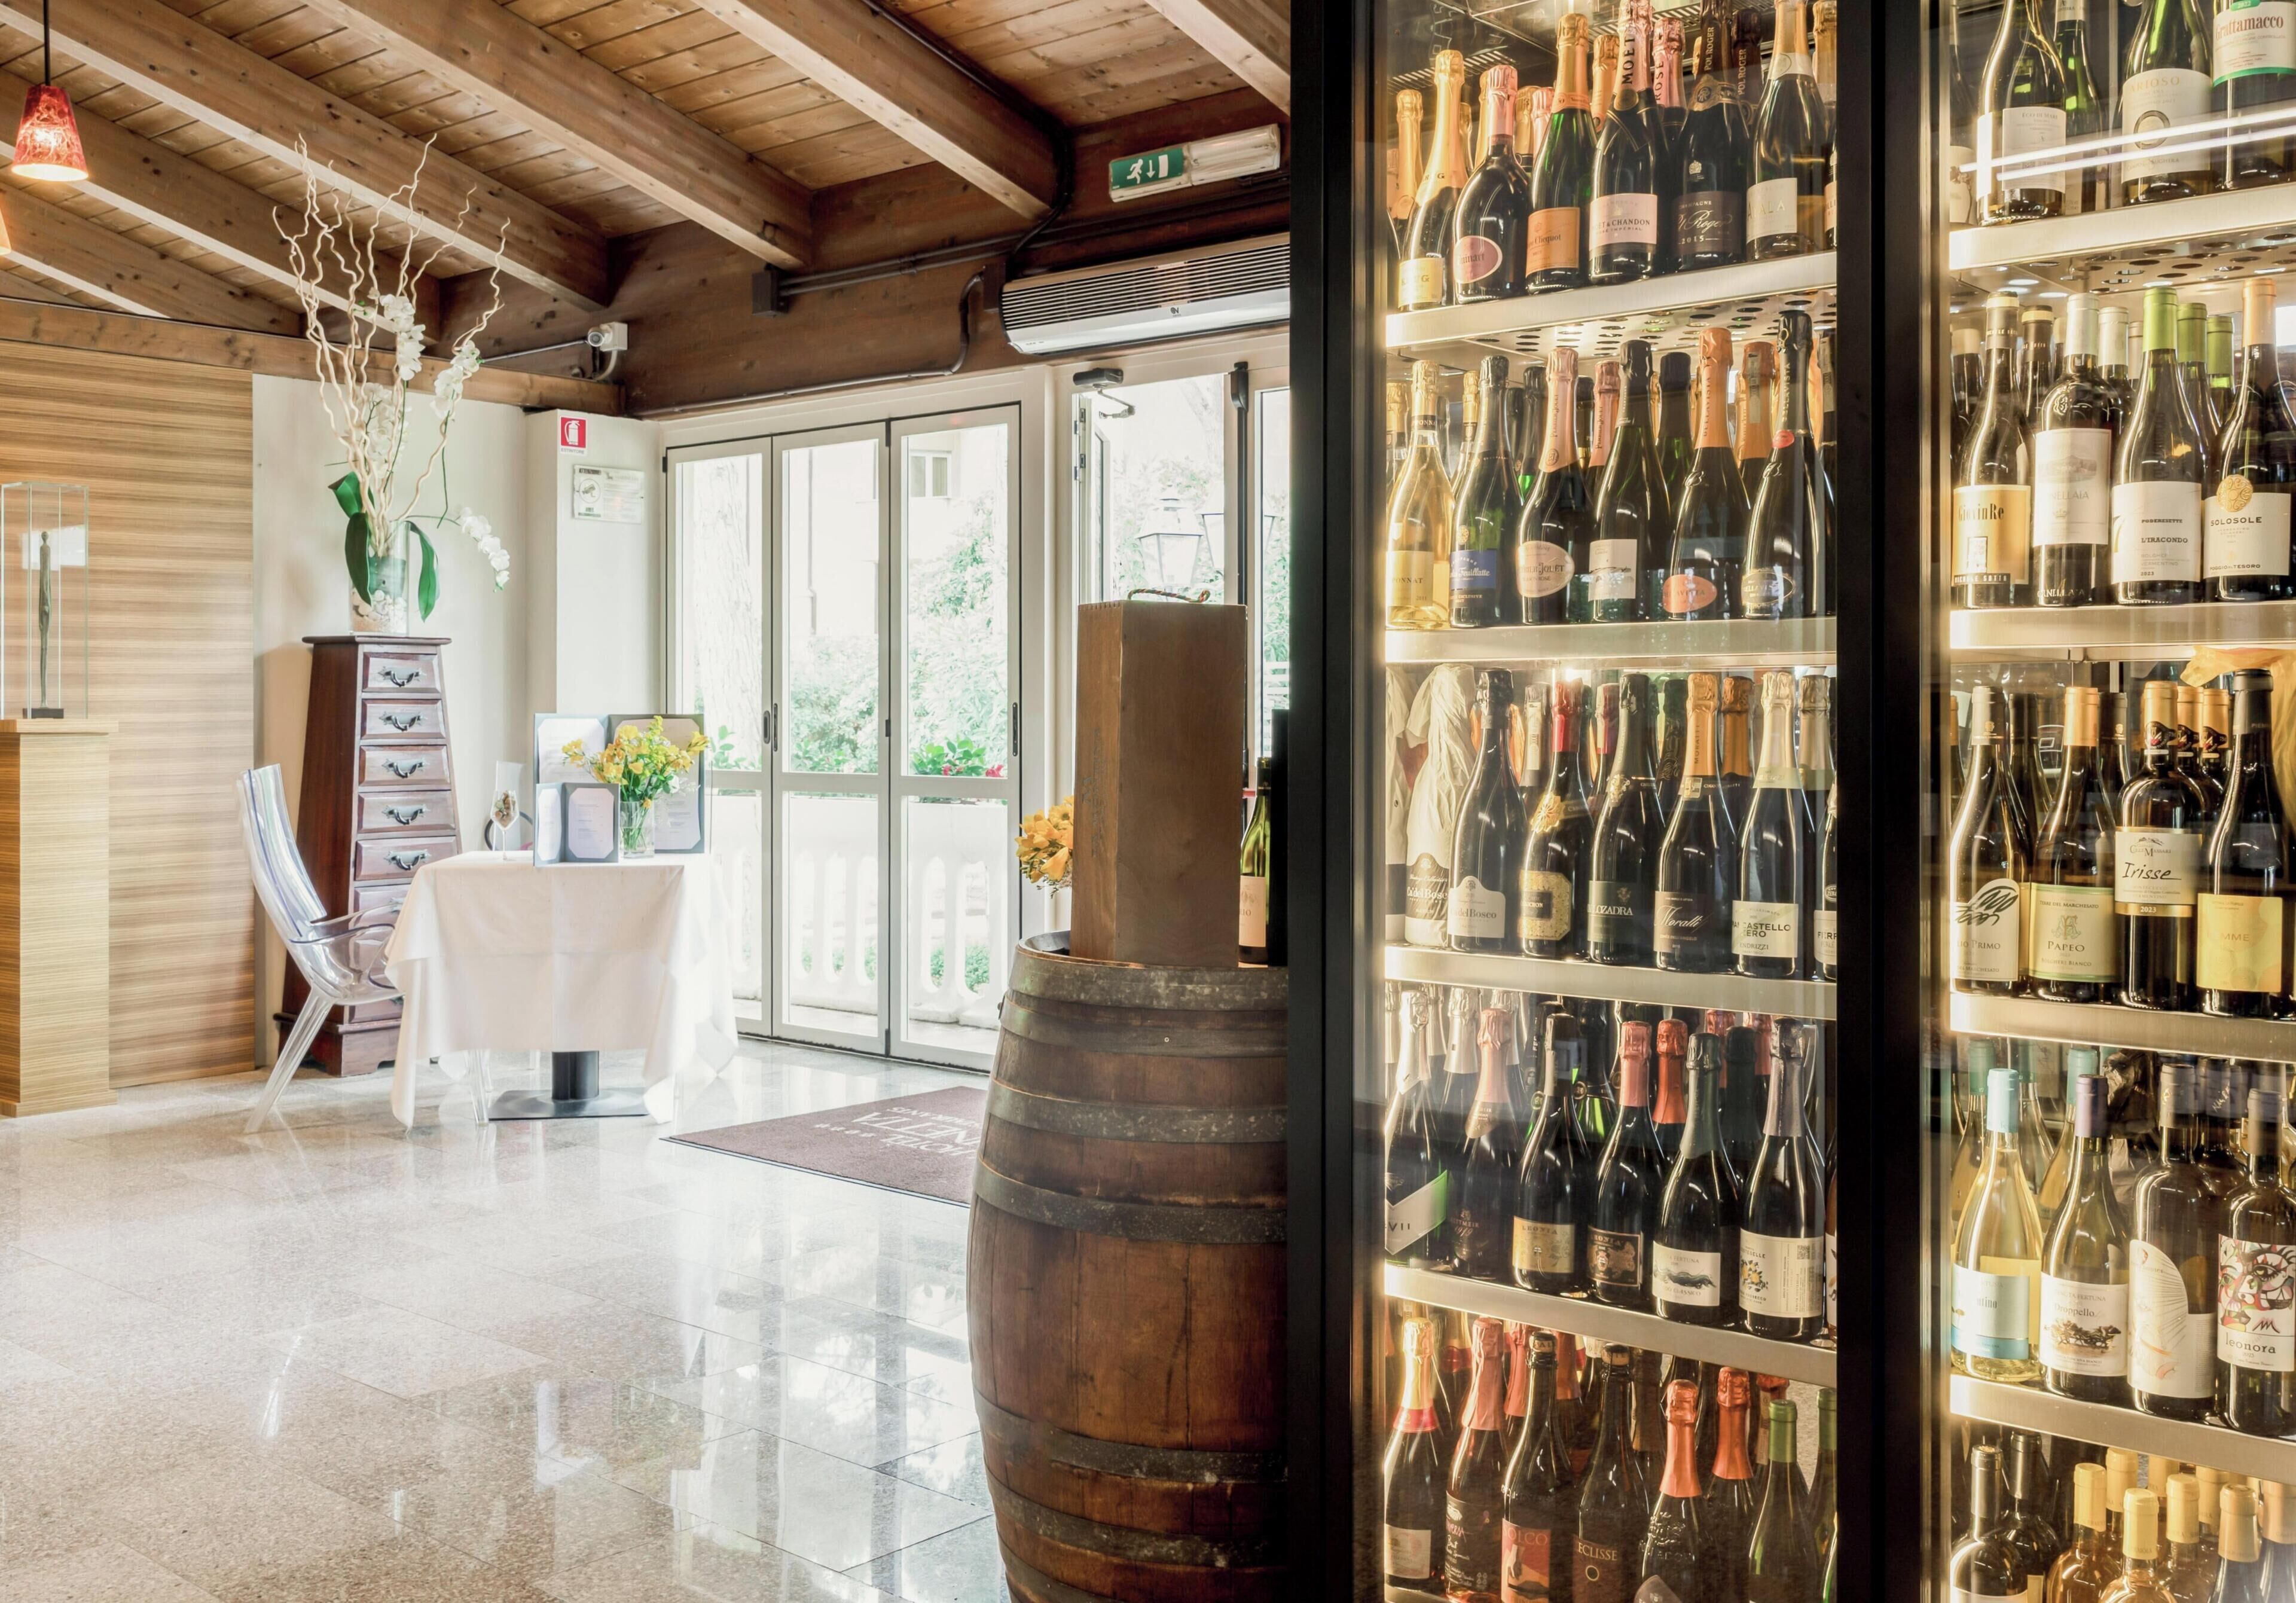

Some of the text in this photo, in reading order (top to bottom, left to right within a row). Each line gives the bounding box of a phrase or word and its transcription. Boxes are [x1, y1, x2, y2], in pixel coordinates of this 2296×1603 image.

[2215, 16, 2284, 41] Grattamacco
[1706, 27, 1715, 55] ROGER
[1611, 218, 1650, 227] CHANDON
[1534, 234, 1561, 244] Clicquot
[2210, 517, 2263, 527] SOLOSOLE
[2122, 862, 2182, 881] Irisse
[1424, 888, 1448, 900] Bosc
[1470, 908, 1497, 919] Bosco
[1742, 922, 1791, 932] CASTELLO
[1971, 939, 2001, 950] PRIMO
[2047, 941, 2086, 952] PAPEO
[2068, 958, 2092, 967] BIANCO
[1522, 1225, 1558, 1235] LEONIA
[2078, 1293, 2106, 1302] FERTUNA
[2054, 1303, 2095, 1317] Droppello
[2225, 1332, 2276, 1354] leonora
[1578, 1541, 1618, 1561] ECLISSE
